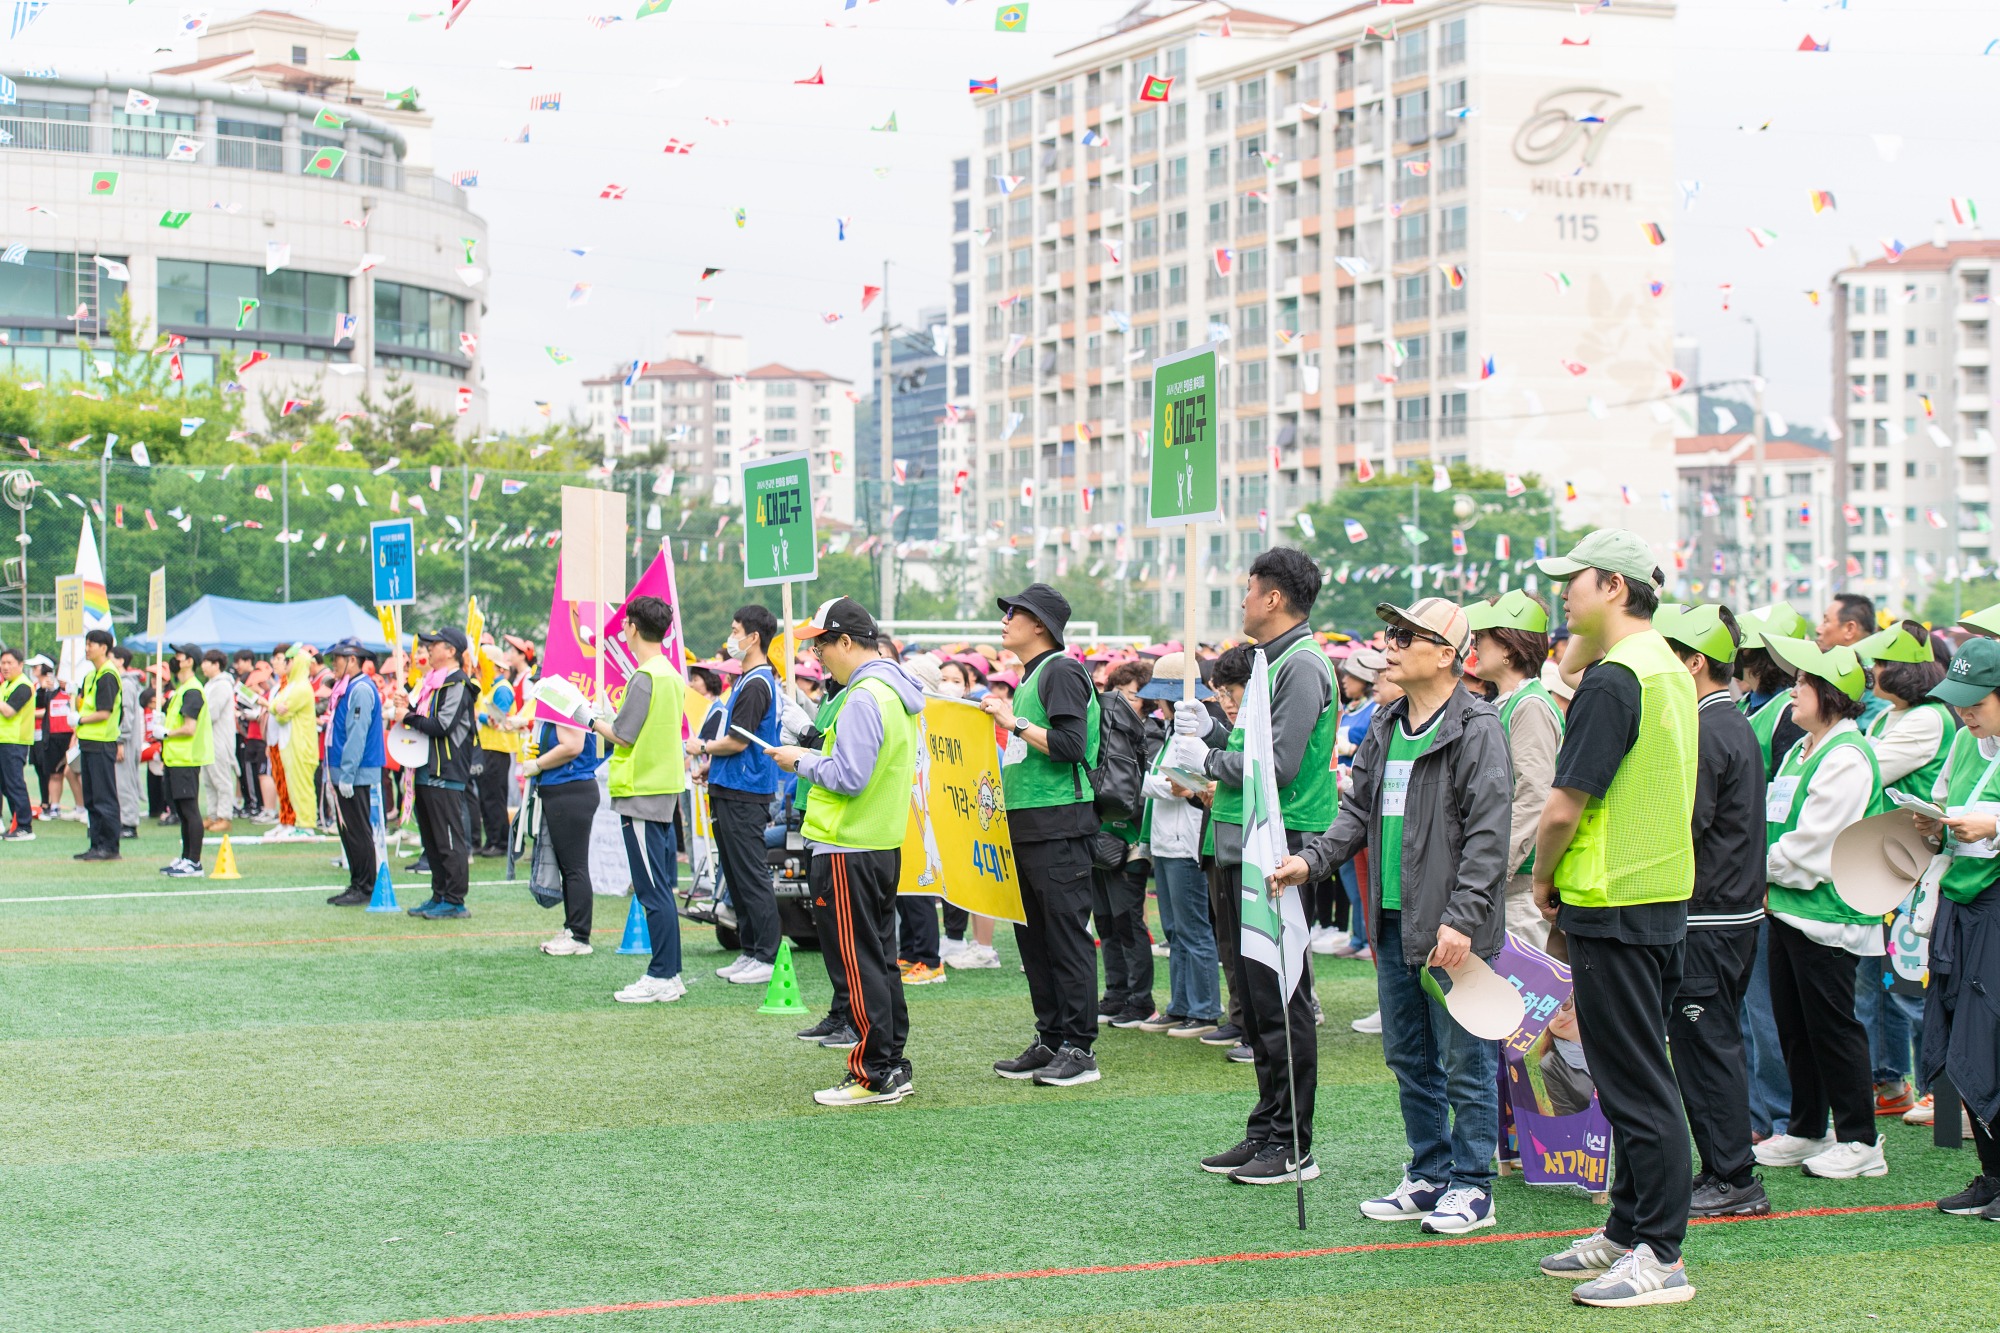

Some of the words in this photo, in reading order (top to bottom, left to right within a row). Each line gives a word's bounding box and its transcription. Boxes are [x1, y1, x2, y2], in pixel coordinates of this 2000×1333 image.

[1531, 179, 1633, 201] HILLSTATE
[1555, 213, 1600, 243] 115
[1164, 394, 1207, 448] 8대교구
[756, 488, 802, 528] 4대교구
[380, 543, 406, 569] 6대교구
